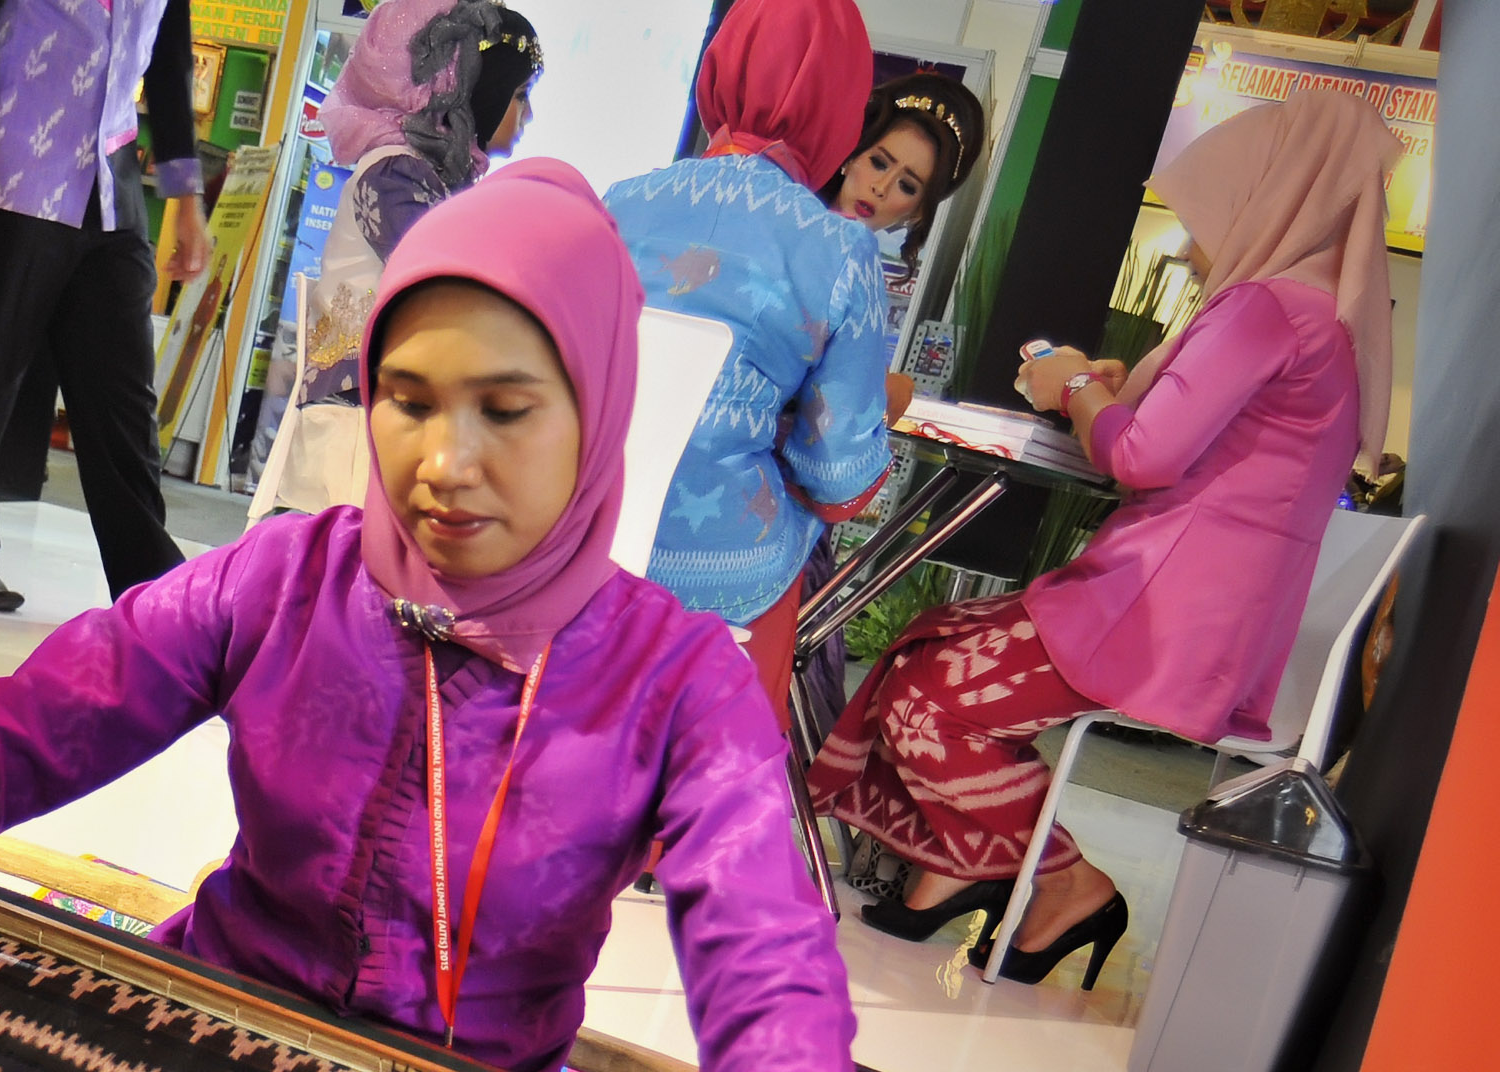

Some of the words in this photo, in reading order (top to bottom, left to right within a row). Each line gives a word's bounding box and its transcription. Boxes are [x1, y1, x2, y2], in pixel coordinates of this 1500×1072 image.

[1217, 62, 1297, 101] SELAMAT
[1367, 83, 1390, 113] DI
[430, 692, 442, 765] INTERNATIONAL
[433, 766, 443, 796] TRADE
[434, 798, 443, 819] AND
[434, 820, 444, 880] INVESTMENT
[436, 881, 447, 919] SUMMIT
[439, 950, 449, 971] 2015
